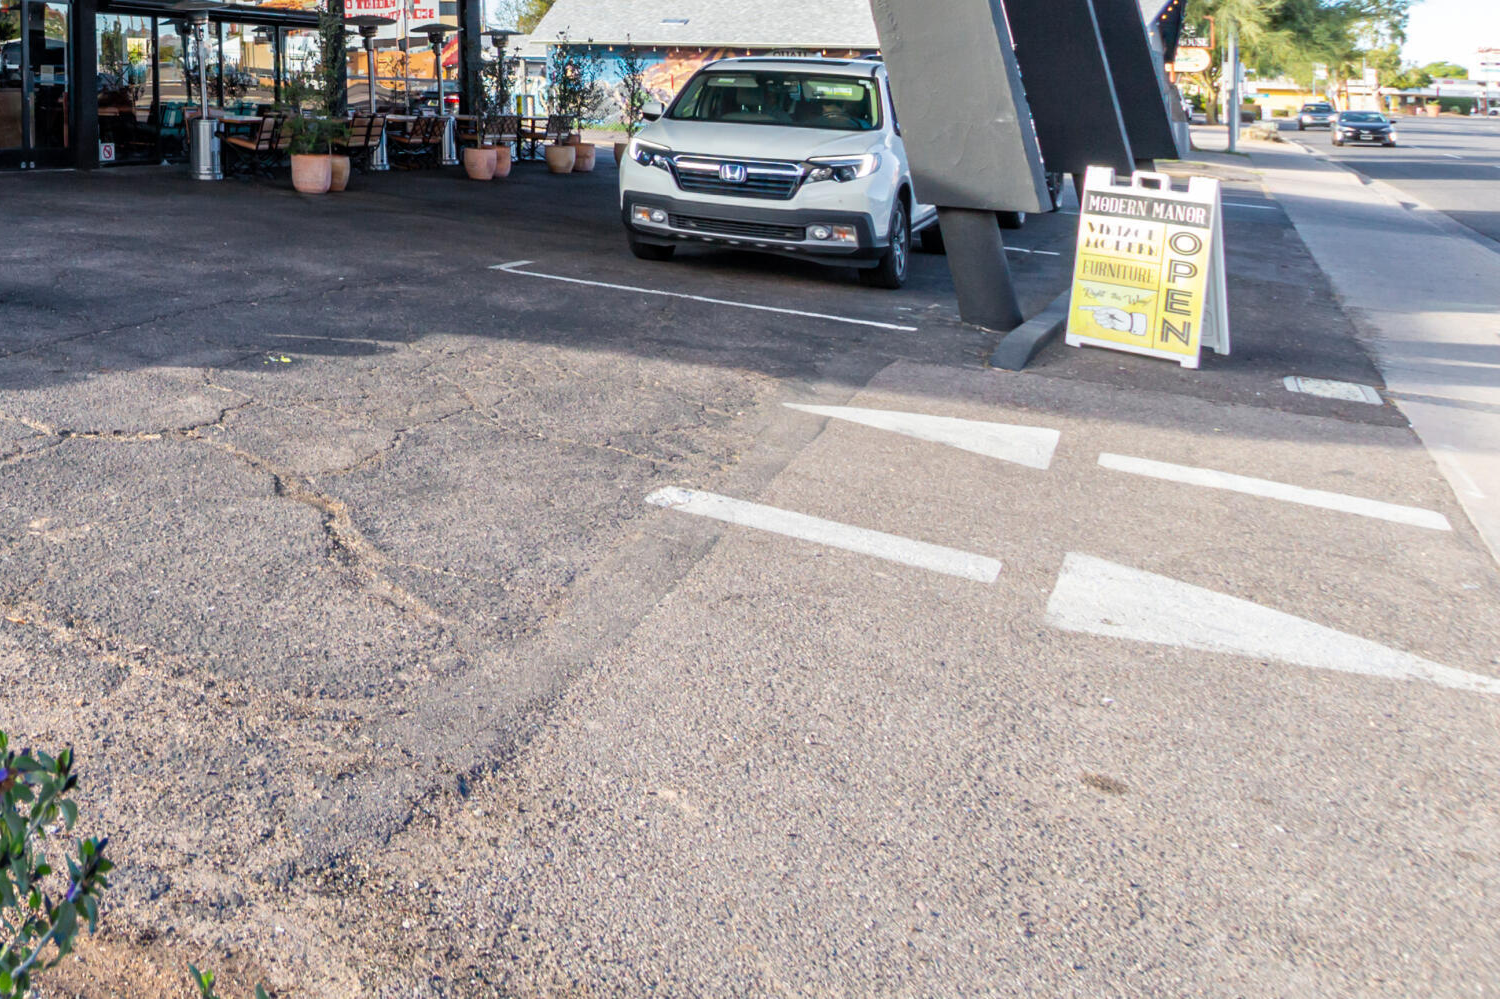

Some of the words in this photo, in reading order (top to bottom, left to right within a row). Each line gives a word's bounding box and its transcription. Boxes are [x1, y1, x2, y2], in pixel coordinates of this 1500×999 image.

[1088, 194, 1148, 217] MODERN
[1152, 203, 1207, 225] MANOR
[1082, 259, 1155, 284] FURNITURE
[1160, 231, 1203, 347] OPEN
